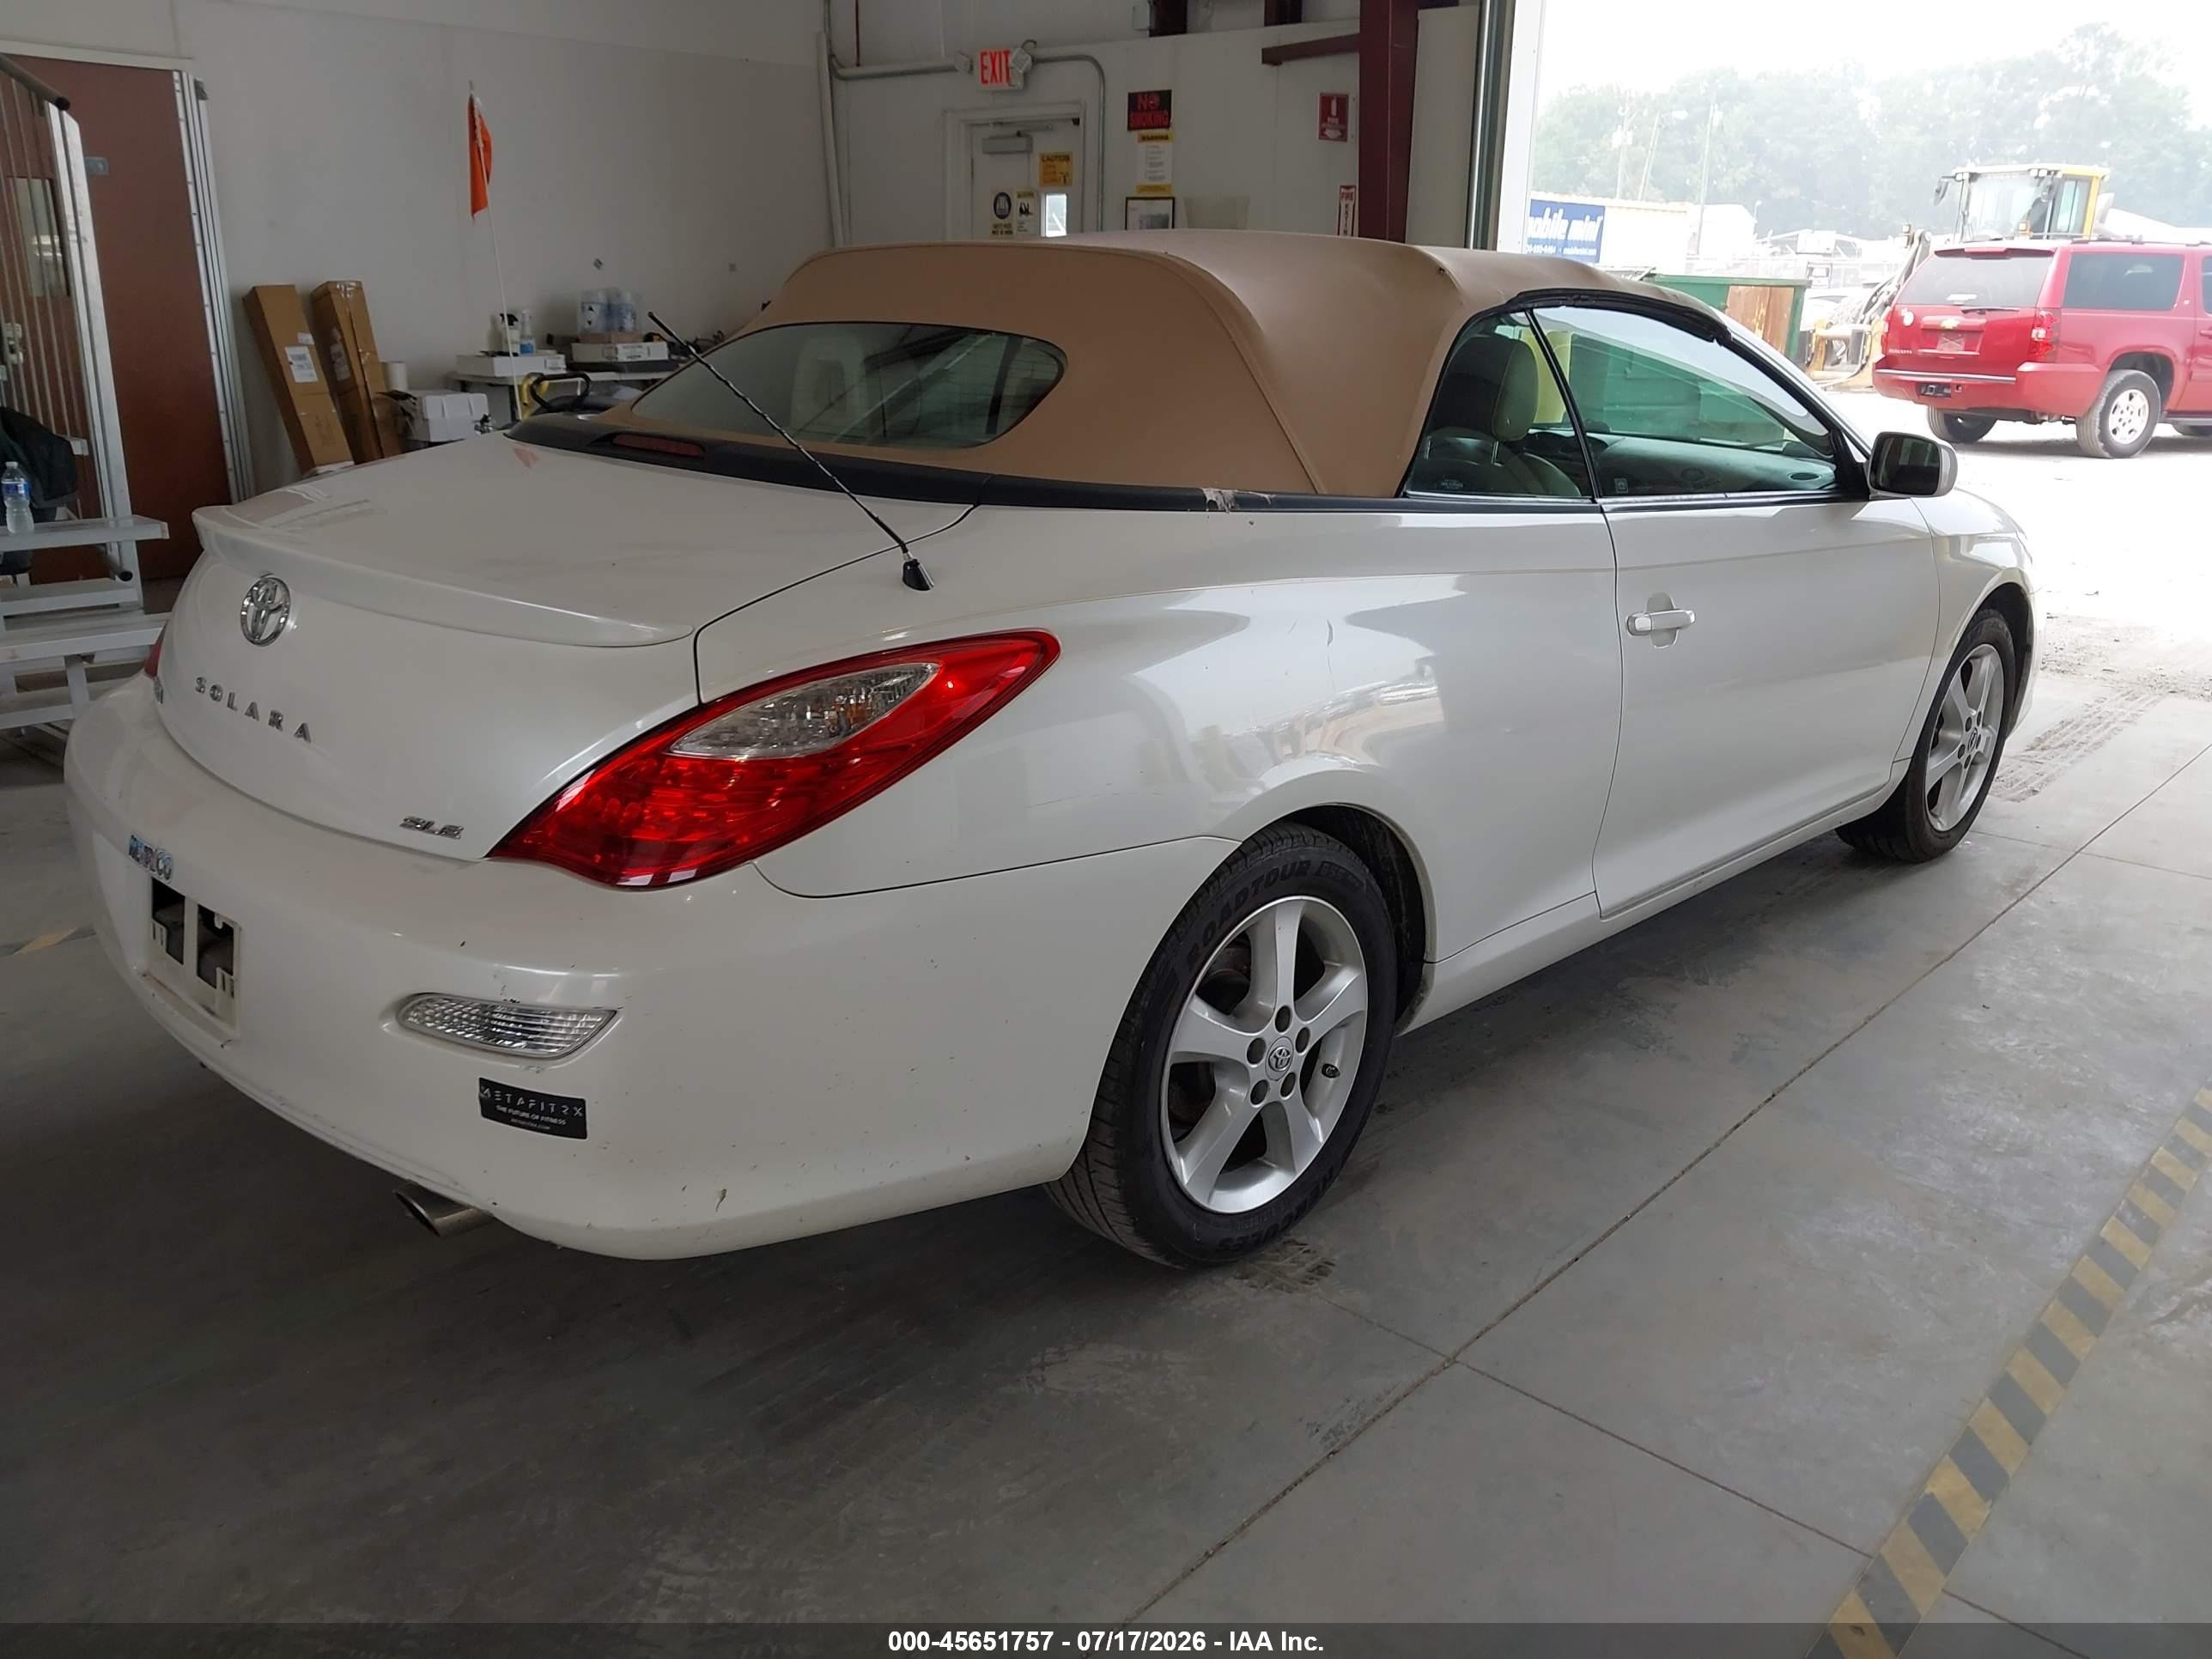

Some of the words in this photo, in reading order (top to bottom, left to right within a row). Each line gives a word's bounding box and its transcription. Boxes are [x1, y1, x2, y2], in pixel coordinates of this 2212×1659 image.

[980, 50, 1011, 83] EXIT
[1138, 94, 1160, 111] NO
[195, 677, 311, 743] SOLARA
[399, 816, 464, 839] SLE
